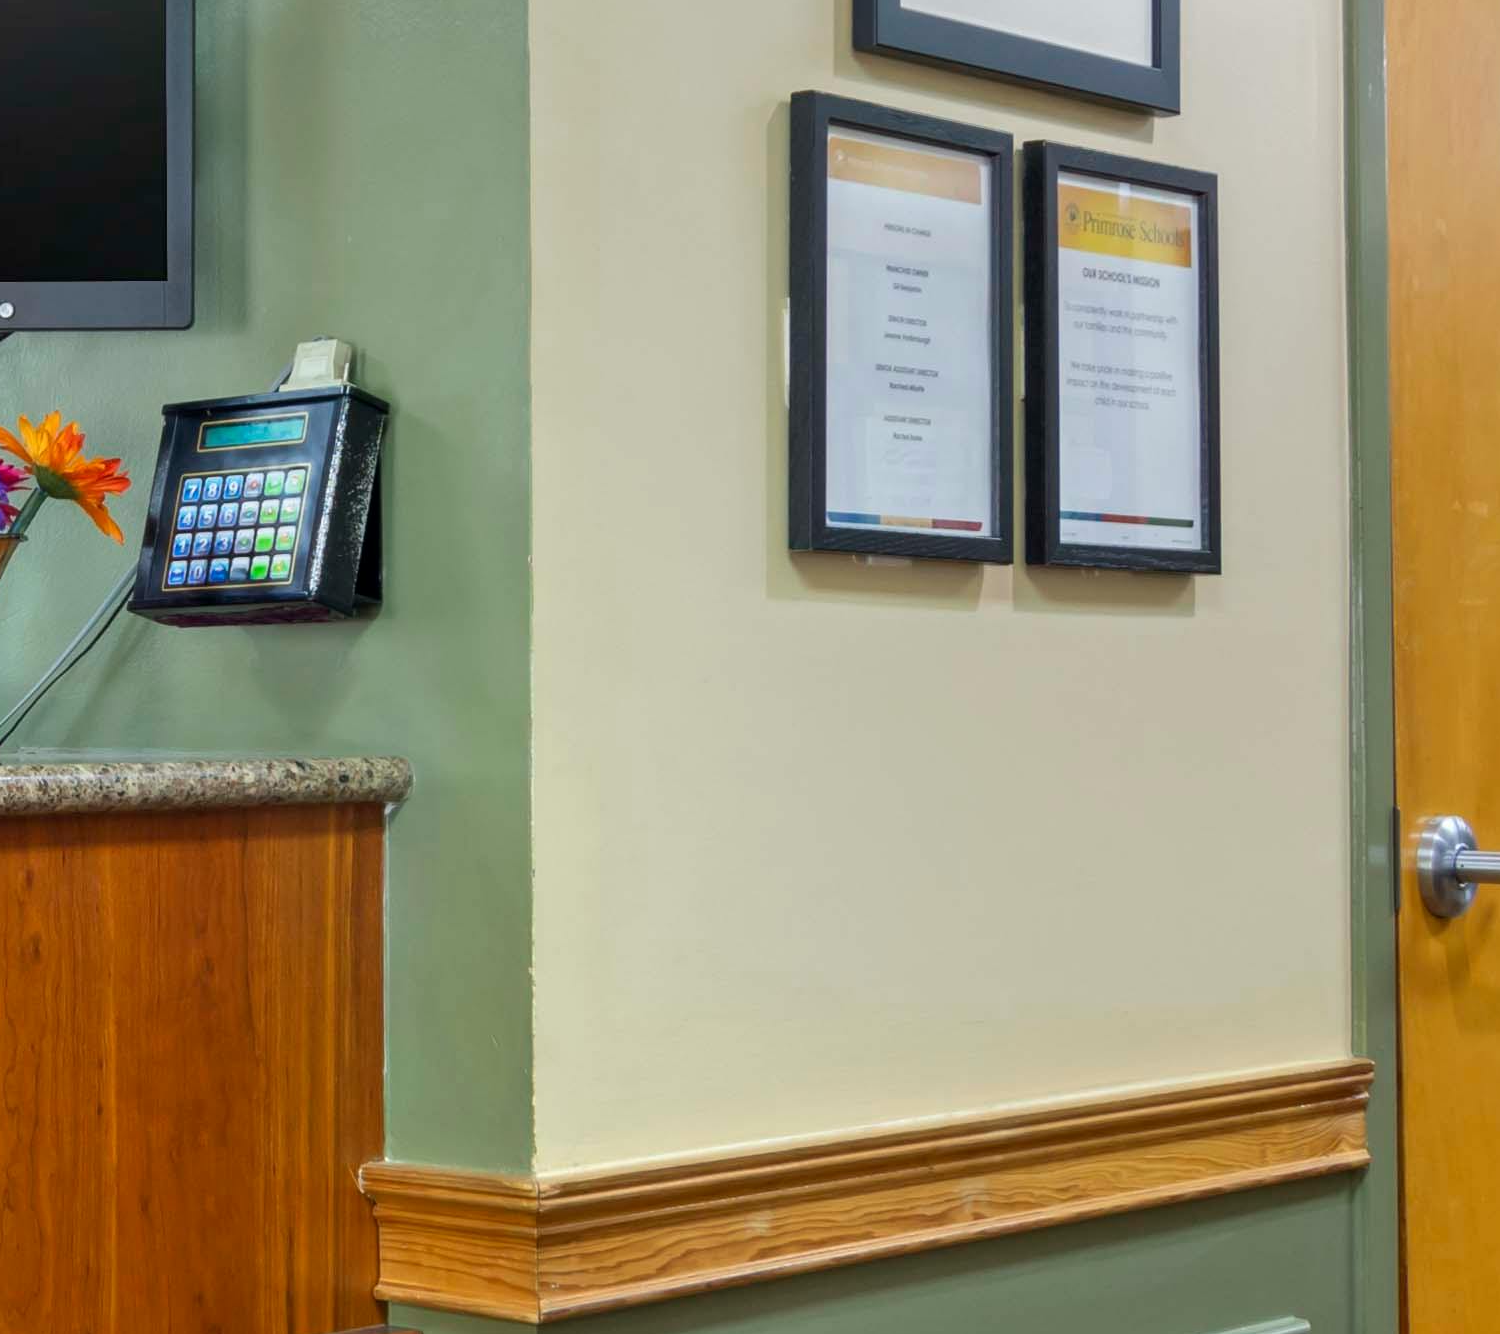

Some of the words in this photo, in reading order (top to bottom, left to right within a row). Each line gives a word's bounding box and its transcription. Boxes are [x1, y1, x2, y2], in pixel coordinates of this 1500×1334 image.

[1083, 210, 1136, 240] Primrose
[1138, 220, 1184, 248] Schools
[188, 485, 197, 498] 7
[208, 483, 217, 497] 8
[228, 481, 239, 495] 9
[182, 512, 192, 526] 4
[202, 511, 213, 524] 5
[224, 509, 233, 523] 6
[178, 540, 187, 554] 1
[199, 539, 209, 552] 2
[219, 537, 229, 551] 3
[193, 565, 203, 579] 0
